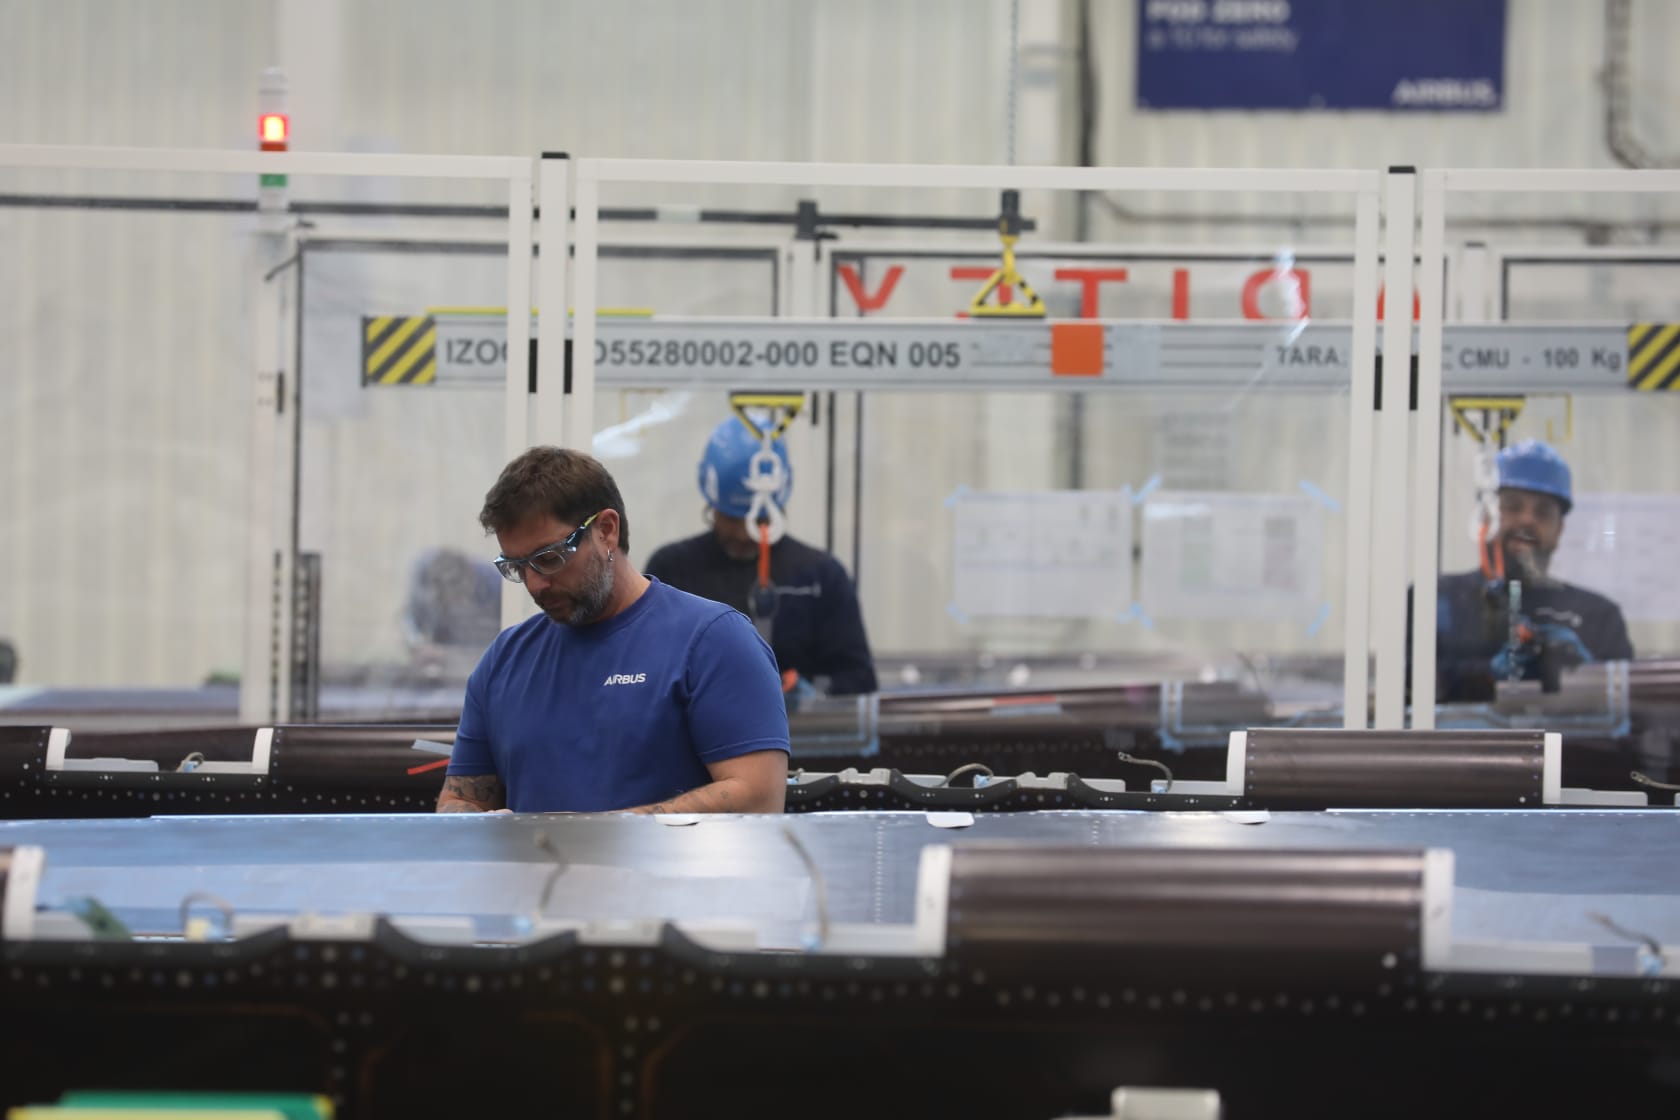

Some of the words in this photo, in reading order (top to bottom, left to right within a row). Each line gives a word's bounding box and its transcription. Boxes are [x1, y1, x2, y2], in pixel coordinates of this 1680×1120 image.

[1393, 80, 1497, 106] AIRBUS
[829, 341, 897, 369] EQN
[908, 341, 961, 368] 005
[1458, 346, 1509, 369] CMU
[1542, 347, 1580, 368] 100
[1591, 348, 1623, 371] Kg
[603, 673, 647, 686] AIRBUS
